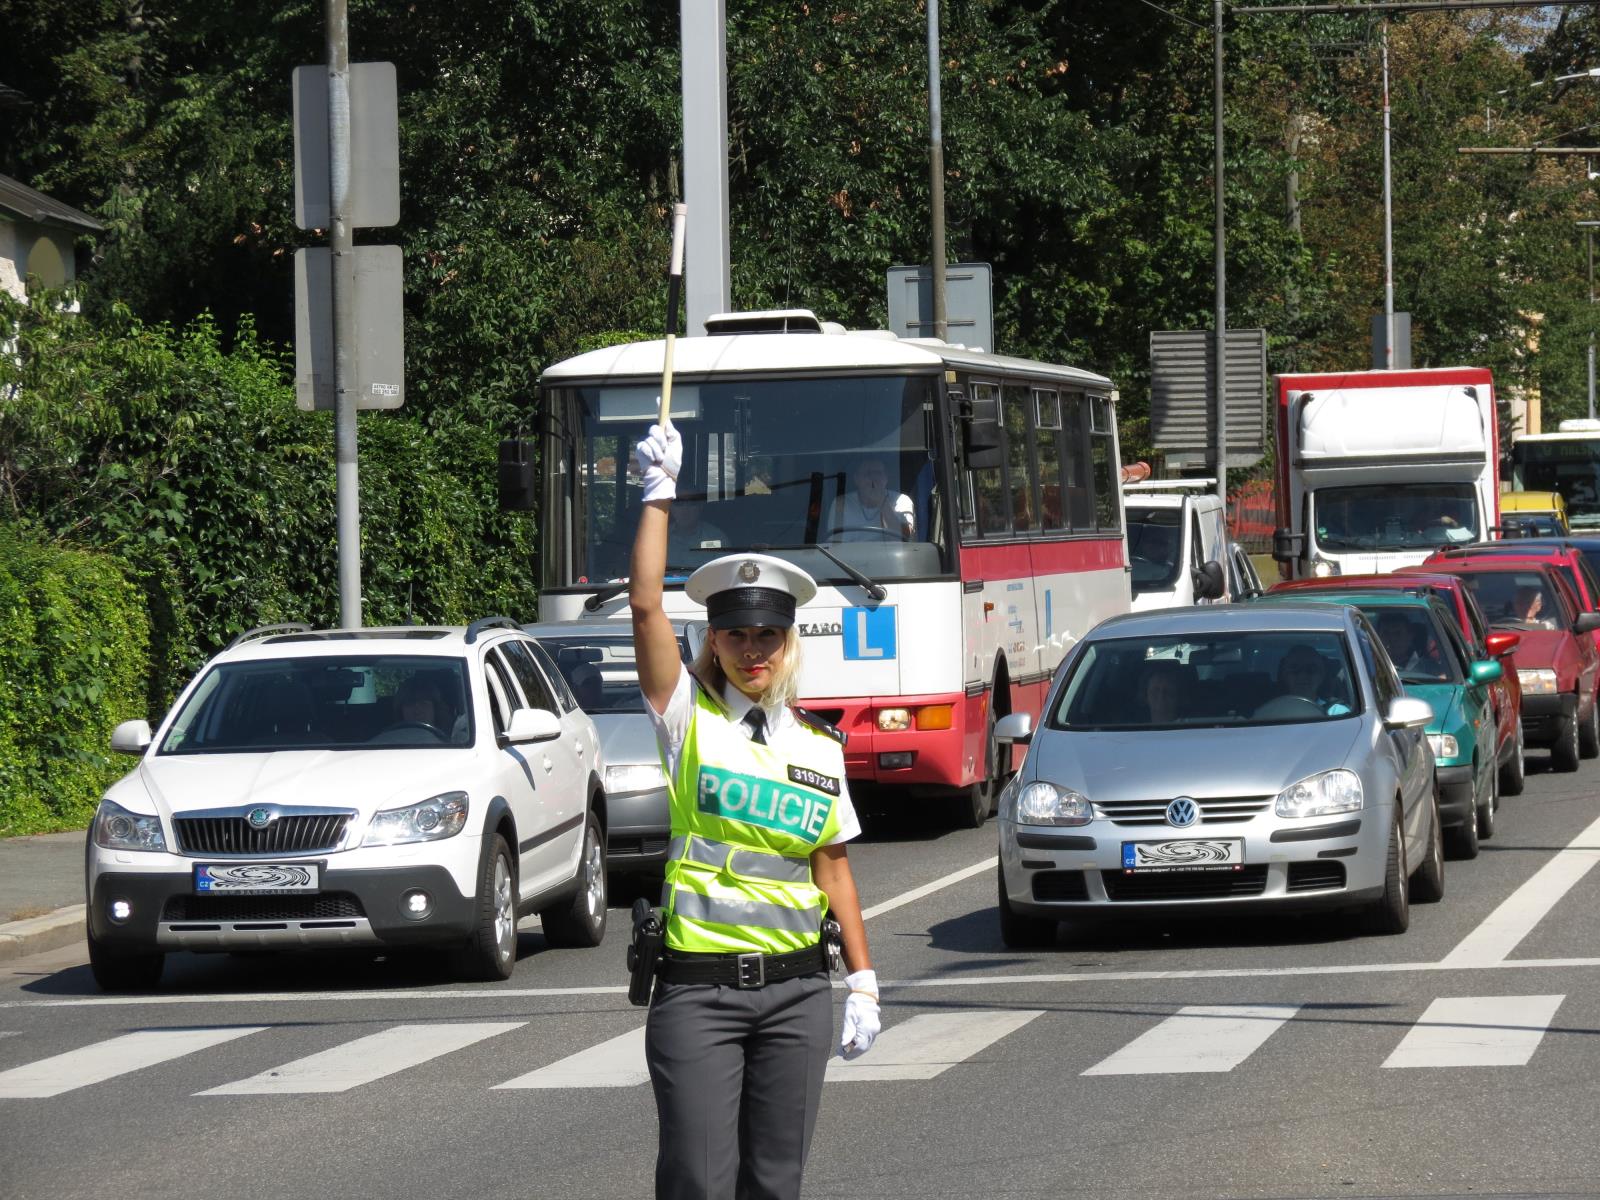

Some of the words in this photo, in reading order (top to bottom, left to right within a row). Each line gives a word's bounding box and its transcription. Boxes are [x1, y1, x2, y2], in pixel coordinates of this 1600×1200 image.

[857, 611, 883, 657] L
[794, 768, 834, 790] 319724
[700, 773, 829, 837] POLICIE
